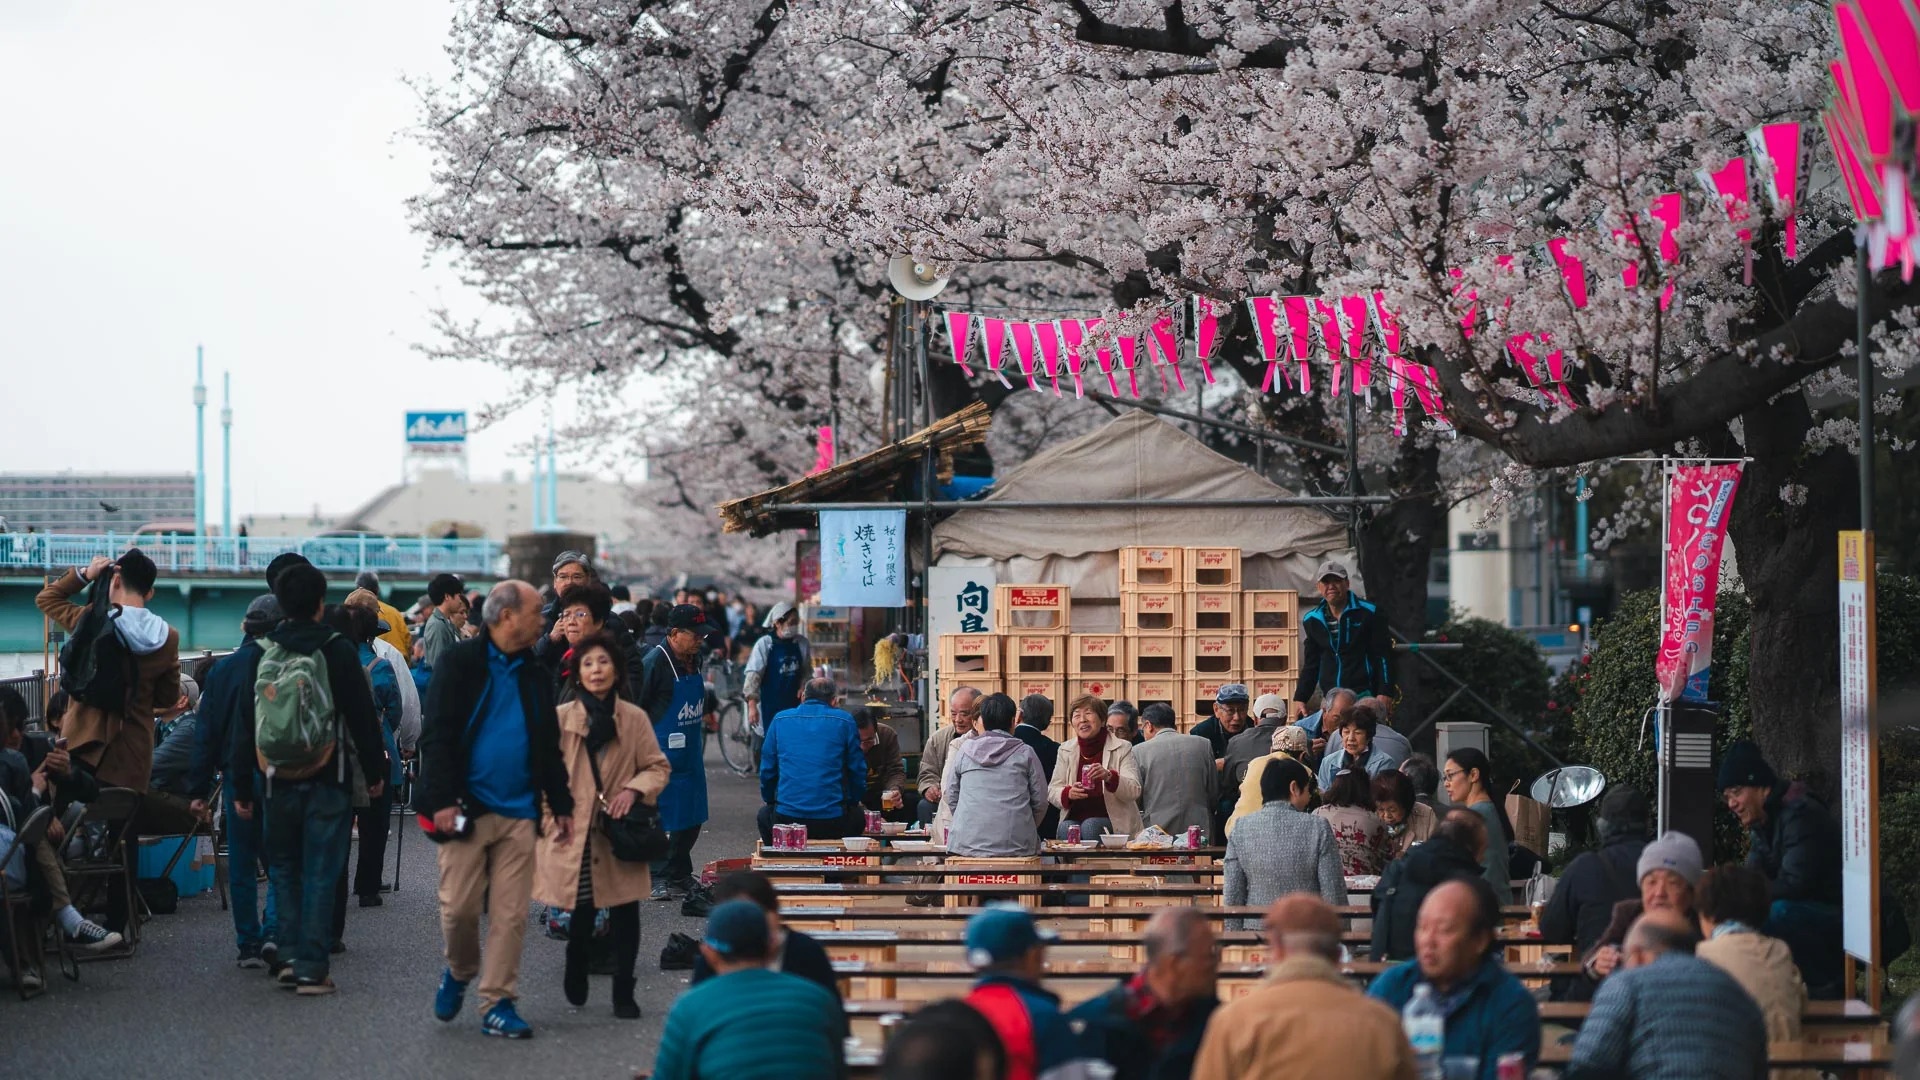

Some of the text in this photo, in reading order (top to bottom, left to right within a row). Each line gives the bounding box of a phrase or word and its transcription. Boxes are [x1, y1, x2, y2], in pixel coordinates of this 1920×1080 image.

[964, 316, 980, 362] 桜まつり
[1174, 304, 1185, 361] 桜まつり
[1276, 334, 1289, 358] つり
[1000, 338, 1011, 369] まつり
[1134, 331, 1145, 368] まつり
[1210, 336, 1225, 359] つり
[408, 415, 464, 438] Asahi
[854, 523, 877, 587] 焼きそば
[884, 525, 897, 586] 桜まつり限定
[1012, 597, 1058, 605] アサヒビール
[824, 856, 866, 866] アサヒビー
[960, 875, 1017, 884] アサヒビール
